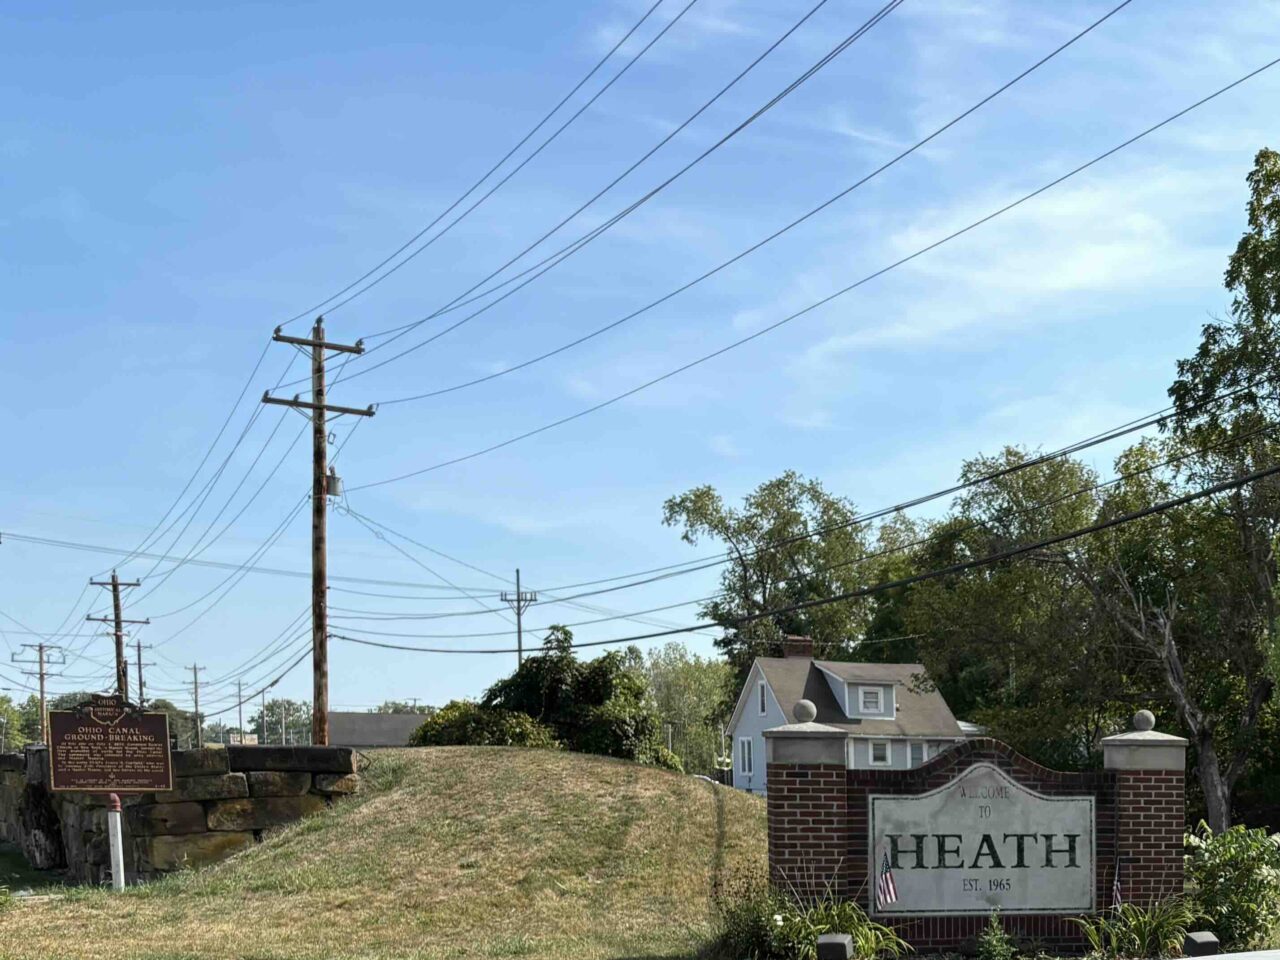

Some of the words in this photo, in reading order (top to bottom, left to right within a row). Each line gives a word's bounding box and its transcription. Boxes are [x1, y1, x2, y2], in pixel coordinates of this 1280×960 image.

[108, 727, 141, 735] CANAL
[959, 785, 1010, 799] WCOME
[979, 805, 991, 818] TO
[885, 833, 1081, 869] HEATH
[963, 879, 982, 892] EST.
[988, 878, 1011, 892] 1965
